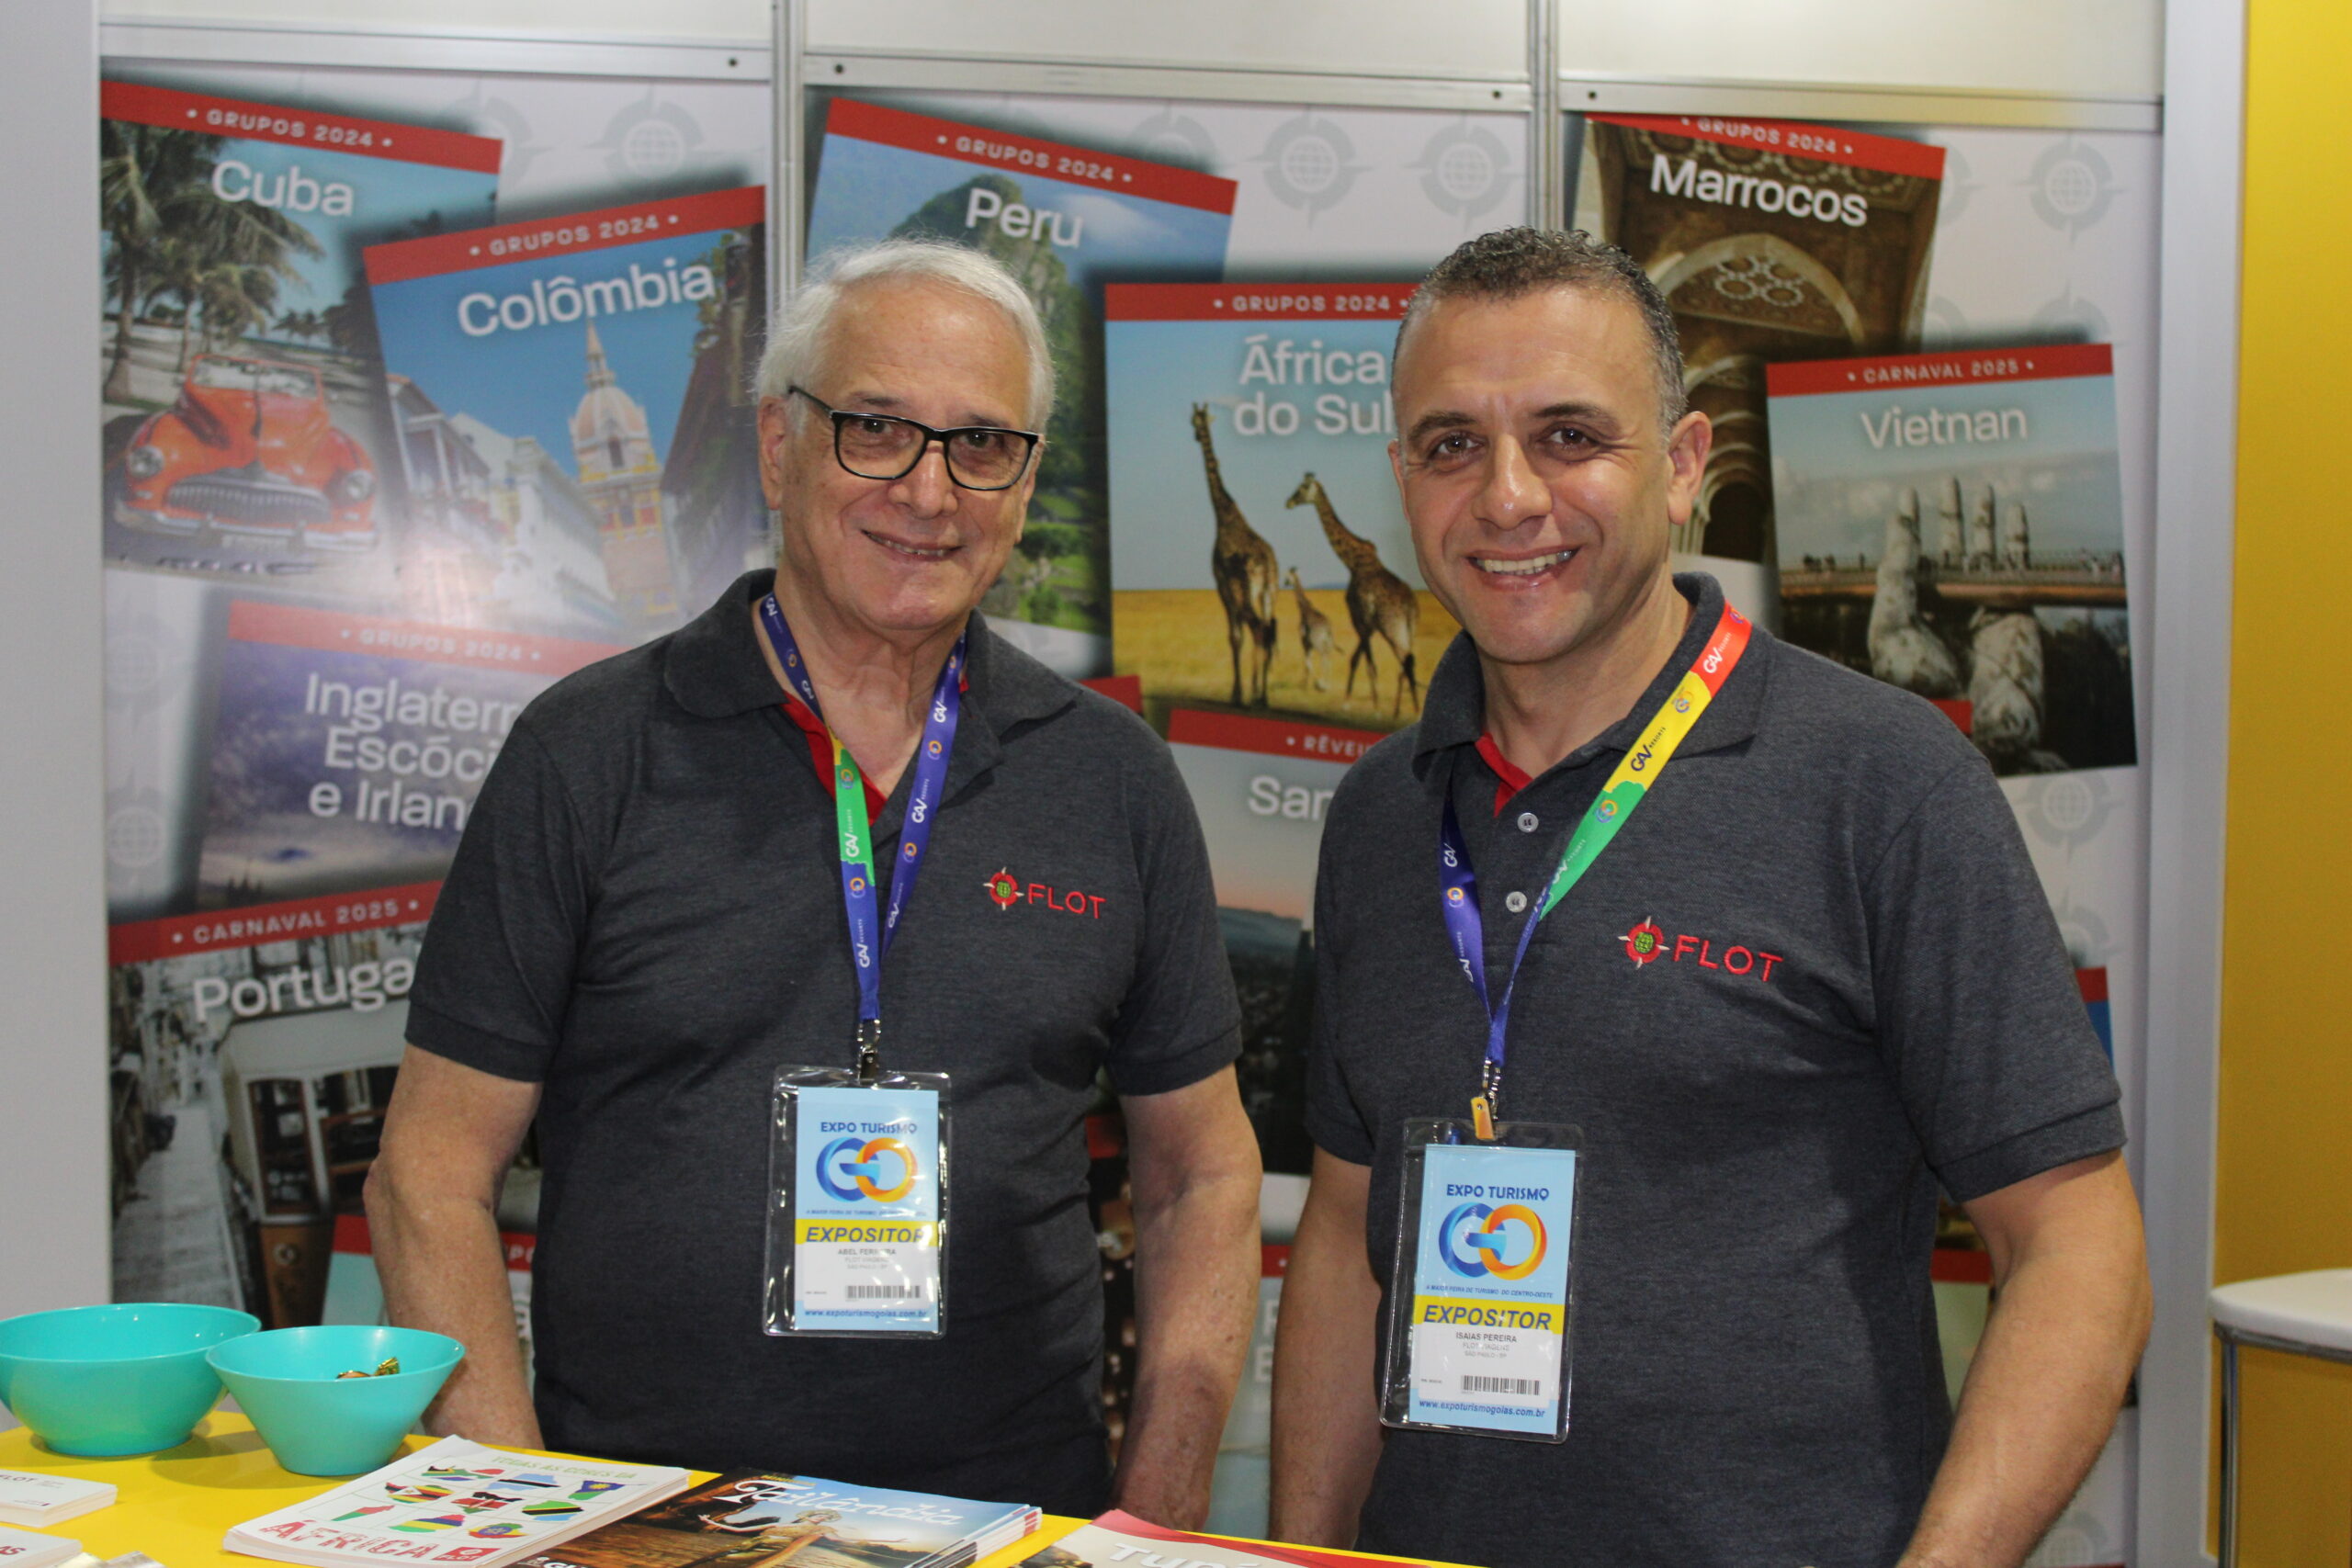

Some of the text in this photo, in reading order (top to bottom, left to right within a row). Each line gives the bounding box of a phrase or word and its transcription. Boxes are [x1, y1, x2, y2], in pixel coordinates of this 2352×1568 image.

[207, 108, 373, 147] GRUPOS 2024
[1697, 118, 1837, 153] GRUPOS 2024
[956, 135, 1114, 183] GRUPOS 2024
[211, 160, 354, 217] Cuba
[1649, 152, 1868, 228] Marrocos
[489, 214, 660, 256] GRUPOS 2024
[965, 187, 1085, 248] Peru
[458, 256, 716, 337] Colômbia
[1232, 295, 1391, 311] GRUPOS 2024
[1239, 333, 1386, 385] África
[1863, 358, 2019, 385] CARNAVAL 2025
[1234, 389, 1395, 435] do Sul
[1860, 405, 2028, 450] Vietnan
[359, 628, 522, 660] GRUPOS 2024
[1703, 647, 1724, 673] GAV
[305, 672, 522, 734] Inglaterr
[324, 726, 497, 782] Escóci
[1631, 745, 1652, 772] GAV
[309, 780, 474, 831] e Irlan
[911, 798, 928, 823] GAV
[845, 832, 859, 857] GAV
[193, 899, 399, 944] CARNAVAL 2025
[1027, 883, 1106, 919] FLOT
[856, 942, 870, 967] GAV
[1672, 934, 1783, 982] FLOT
[193, 957, 415, 1023] Portuga
[820, 1122, 918, 1134] EXPO TURISMO
[1446, 1184, 1549, 1201] EXPO TURISMO
[1424, 1304, 1552, 1330] EXPOSITOR
[1455, 1332, 1517, 1342] ISAIAS PEREIRA
[1419, 1399, 1544, 1417] www.expoturismogoias.com.br
[712, 1479, 964, 1526] Tailândia
[260, 1518, 440, 1559] ÁFRICA
